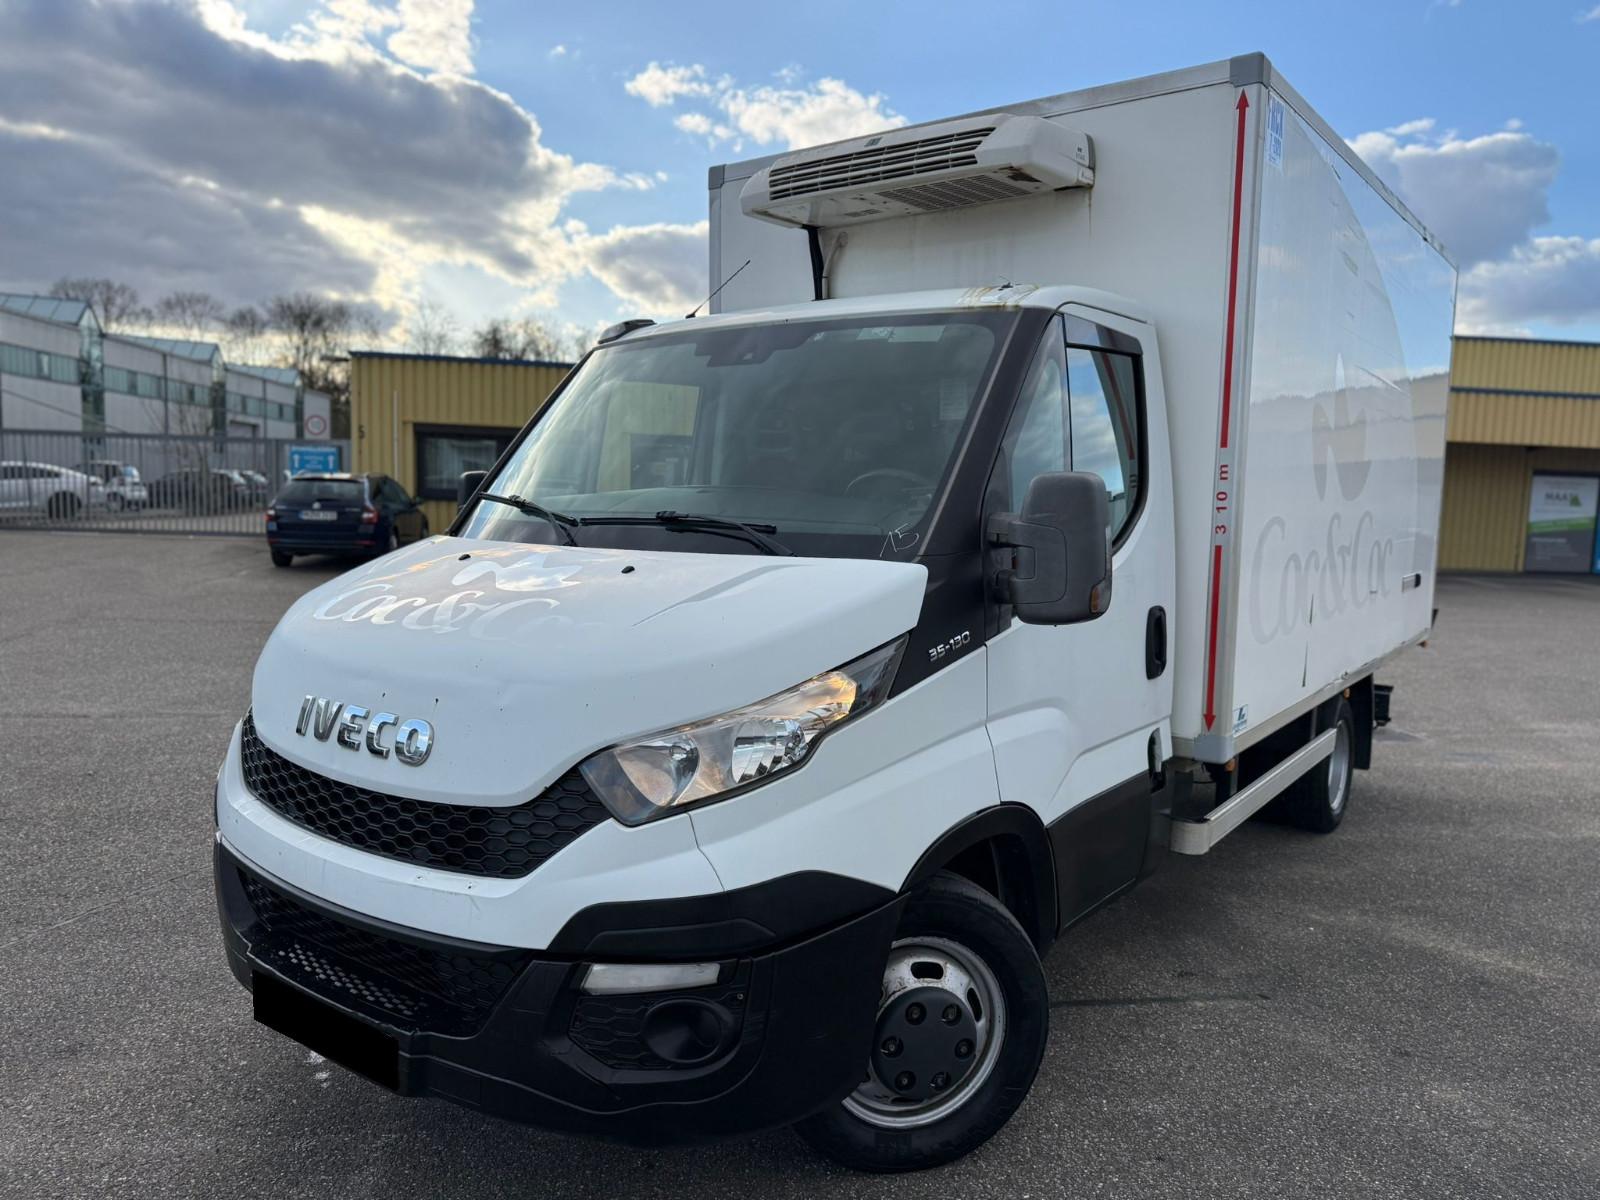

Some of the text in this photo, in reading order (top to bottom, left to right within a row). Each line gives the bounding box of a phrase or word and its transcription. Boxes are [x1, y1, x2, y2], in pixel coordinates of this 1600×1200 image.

[1215, 464, 1229, 535] 3 10 m
[928, 630, 971, 662] 35-130
[296, 694, 435, 767] IVECO
